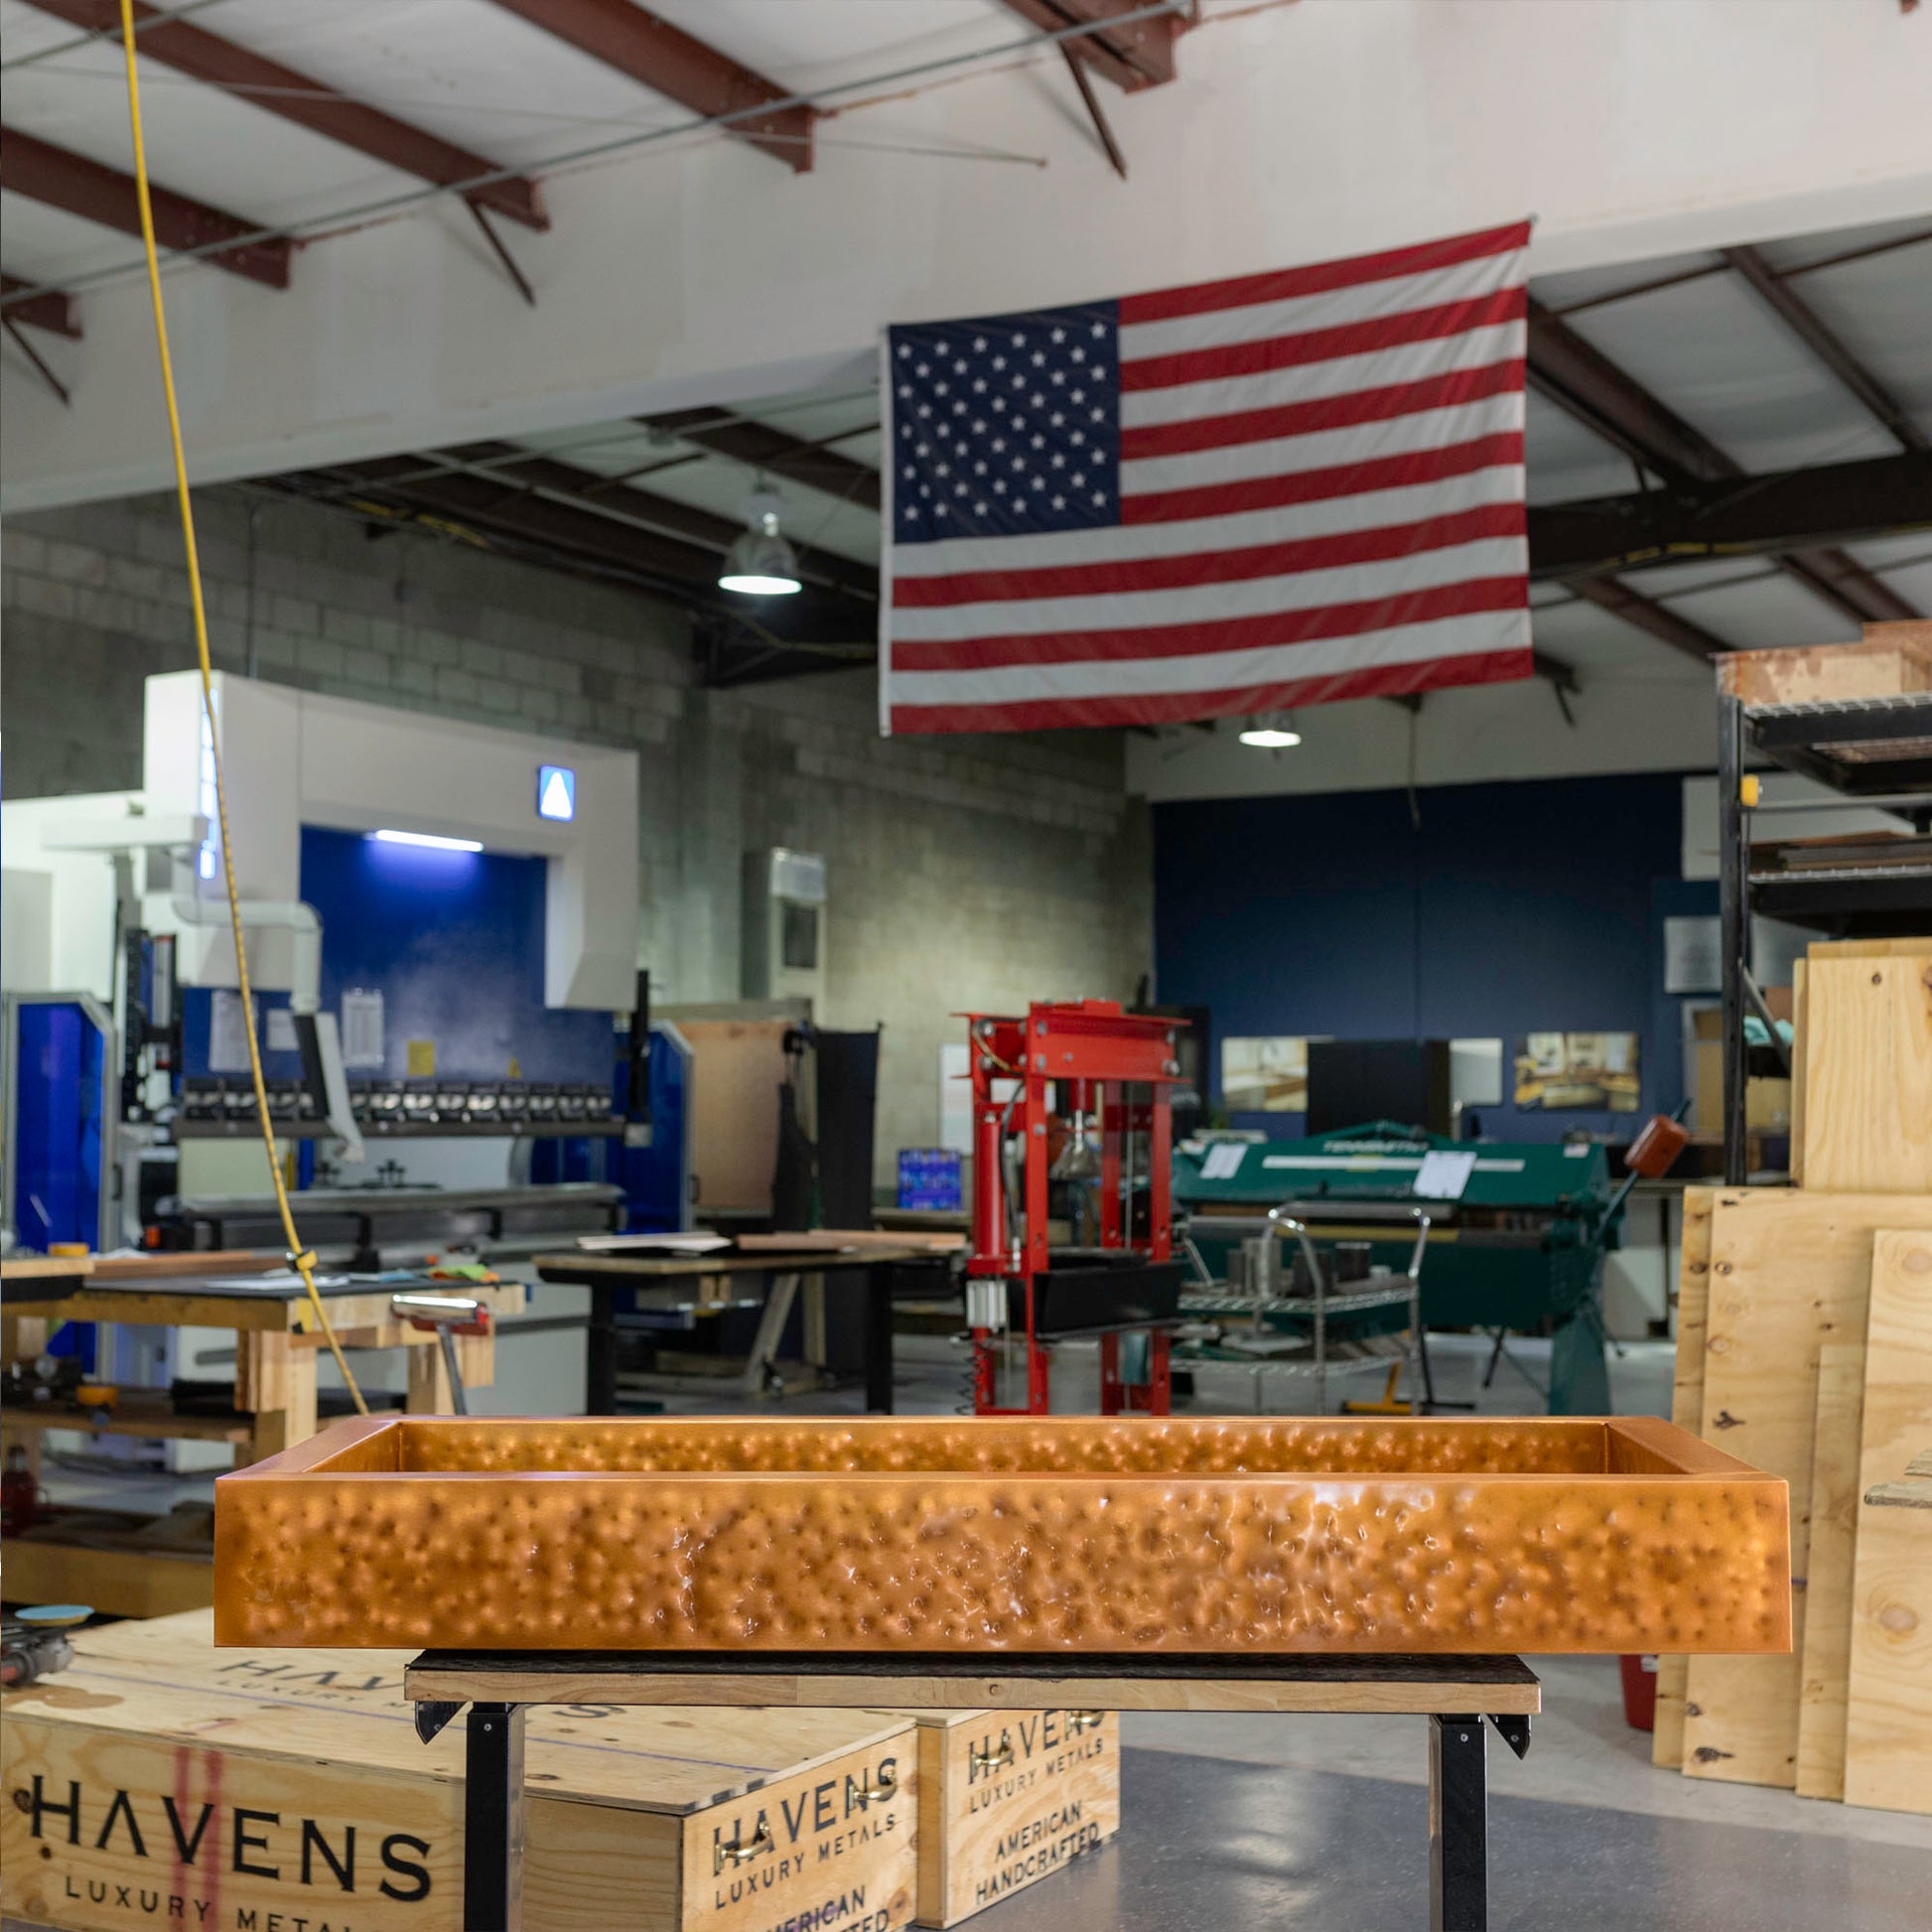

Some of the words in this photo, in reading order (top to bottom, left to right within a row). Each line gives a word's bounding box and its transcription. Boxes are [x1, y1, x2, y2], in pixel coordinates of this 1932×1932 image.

[969, 1769, 1037, 1814] LUXURY
[1046, 1737, 1103, 1777] METALS
[31, 1775, 431, 1902] HAVENS
[716, 1854, 804, 1910] LUXURY
[818, 1814, 897, 1863] METALS
[977, 1822, 1101, 1905] HANDCRAFTED
[996, 1799, 1082, 1863] AMERICAN
[66, 1875, 210, 1921] LUXURY
[237, 1908, 351, 1932] MET
[766, 1885, 865, 1932] ERICAN
